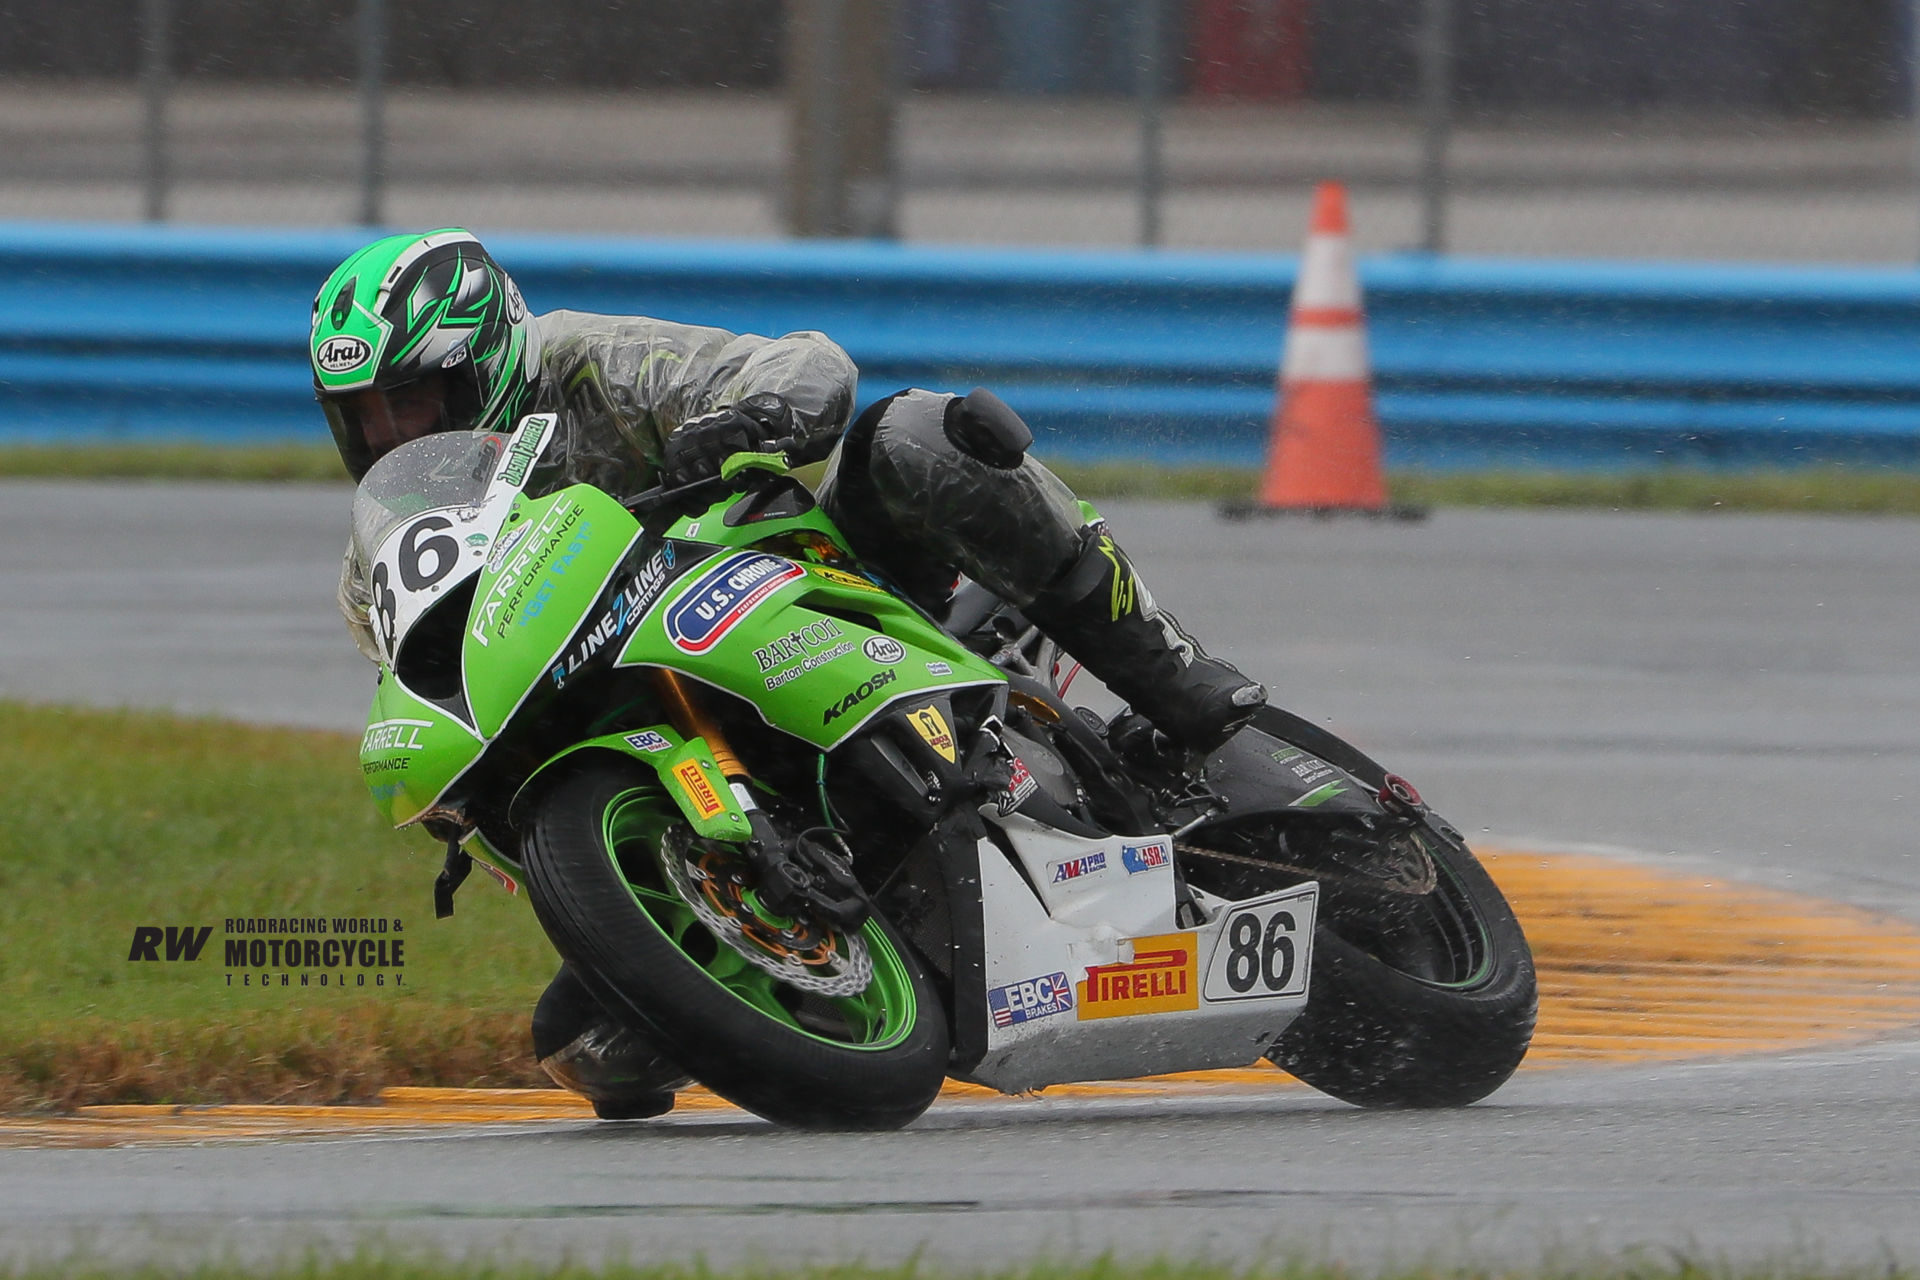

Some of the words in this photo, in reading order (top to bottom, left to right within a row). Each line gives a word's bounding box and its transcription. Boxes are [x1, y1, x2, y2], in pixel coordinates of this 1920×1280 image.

[319, 341, 363, 364] Arai
[509, 417, 549, 458] FARRELL
[497, 452, 532, 487] JASON
[471, 492, 574, 648] FARRELL
[497, 504, 584, 639] PERFORMANCE
[695, 589, 735, 620] U.S.
[727, 558, 782, 591] CHROME
[626, 571, 666, 626] COATINGS
[765, 666, 803, 690] Barton
[802, 641, 855, 671] Construction
[870, 638, 900, 659] Arai
[822, 669, 897, 725] KAOSH
[360, 718, 434, 755] FARRELL
[627, 732, 663, 748] EBC
[680, 765, 720, 813] PIRELLI
[1053, 858, 1089, 883] AMA
[1088, 852, 1106, 866] PRO
[1141, 845, 1169, 867] ASRA
[1226, 911, 1297, 993] 86
[1004, 977, 1054, 1012] EBC
[1084, 949, 1188, 1002] PIRELLI
[1025, 1002, 1058, 1019] BRAKES
